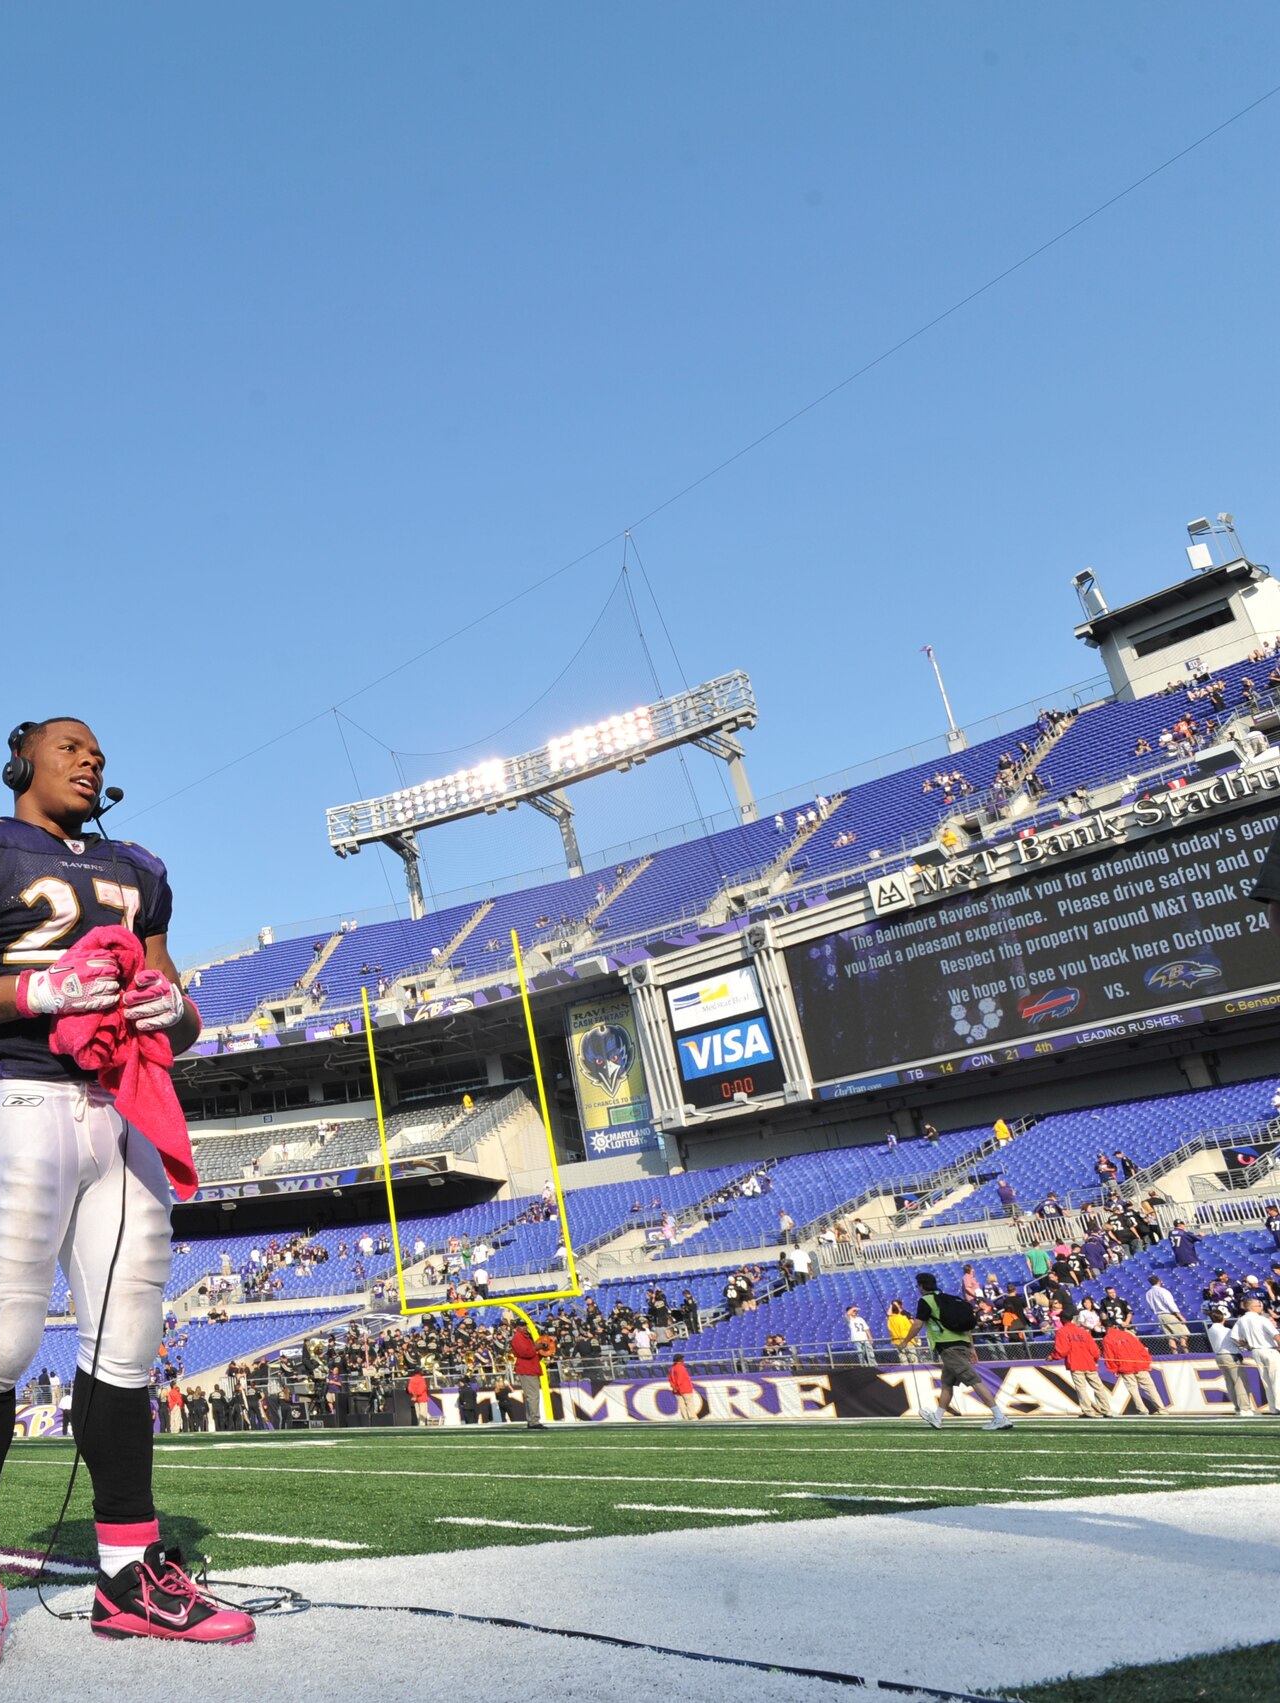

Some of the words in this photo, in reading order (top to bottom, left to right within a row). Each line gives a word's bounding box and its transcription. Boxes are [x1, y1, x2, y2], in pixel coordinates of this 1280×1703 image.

[919, 849, 1000, 896] M&T
[1014, 808, 1127, 865] Bank
[1133, 762, 1280, 828] Stadiu
[60, 861, 104, 871] RAVENS
[851, 935, 873, 952] The
[876, 916, 937, 944] Baltimore
[939, 899, 989, 926] Ravens
[991, 886, 1032, 914] thank
[1036, 878, 1062, 899] you
[1065, 870, 1087, 889] for
[1091, 848, 1170, 881] attending
[1172, 828, 1236, 858] today's
[1241, 815, 1279, 841] gam
[3, 876, 140, 964] 27
[844, 960, 866, 978] you
[870, 951, 892, 970] had
[895, 949, 904, 962] a
[906, 932, 962, 962] pleasant
[965, 910, 1048, 943] experience.
[1057, 891, 1109, 917] Please
[1114, 876, 1156, 901] drive
[1160, 862, 1211, 889] safely
[1216, 851, 1250, 873] and
[940, 949, 995, 975] Respect
[999, 943, 1023, 960] the
[1026, 924, 1088, 954] property
[1093, 909, 1149, 935] around
[1151, 895, 1189, 920] M&T
[1191, 883, 1237, 910] Bank
[948, 985, 969, 1006] We
[972, 977, 1008, 1002] hope
[1009, 973, 1027, 990] to
[1030, 967, 1057, 985] see
[1059, 957, 1088, 982] you
[1091, 948, 1129, 971] back
[1132, 938, 1170, 961] here
[1172, 918, 1242, 951] October
[1245, 911, 1270, 933] 24
[572, 1002, 629, 1020] RAVENS
[573, 1018, 592, 1029] CASH
[594, 1010, 629, 1023] FANTASY
[682, 1023, 770, 1070] VISA
[908, 1069, 924, 1080] TB
[940, 1063, 953, 1073] 14
[971, 1054, 994, 1067] CIN
[1005, 1049, 1019, 1061] 21
[1034, 1042, 1053, 1054] 4th
[1075, 1024, 1126, 1044] LEADING
[1128, 1014, 1184, 1033] RUSHER:
[721, 1077, 754, 1098] 0:00
[609, 1127, 651, 1141] MARYLAND
[610, 1136, 644, 1149] LOTTERY
[276, 1175, 340, 1193] WIN
